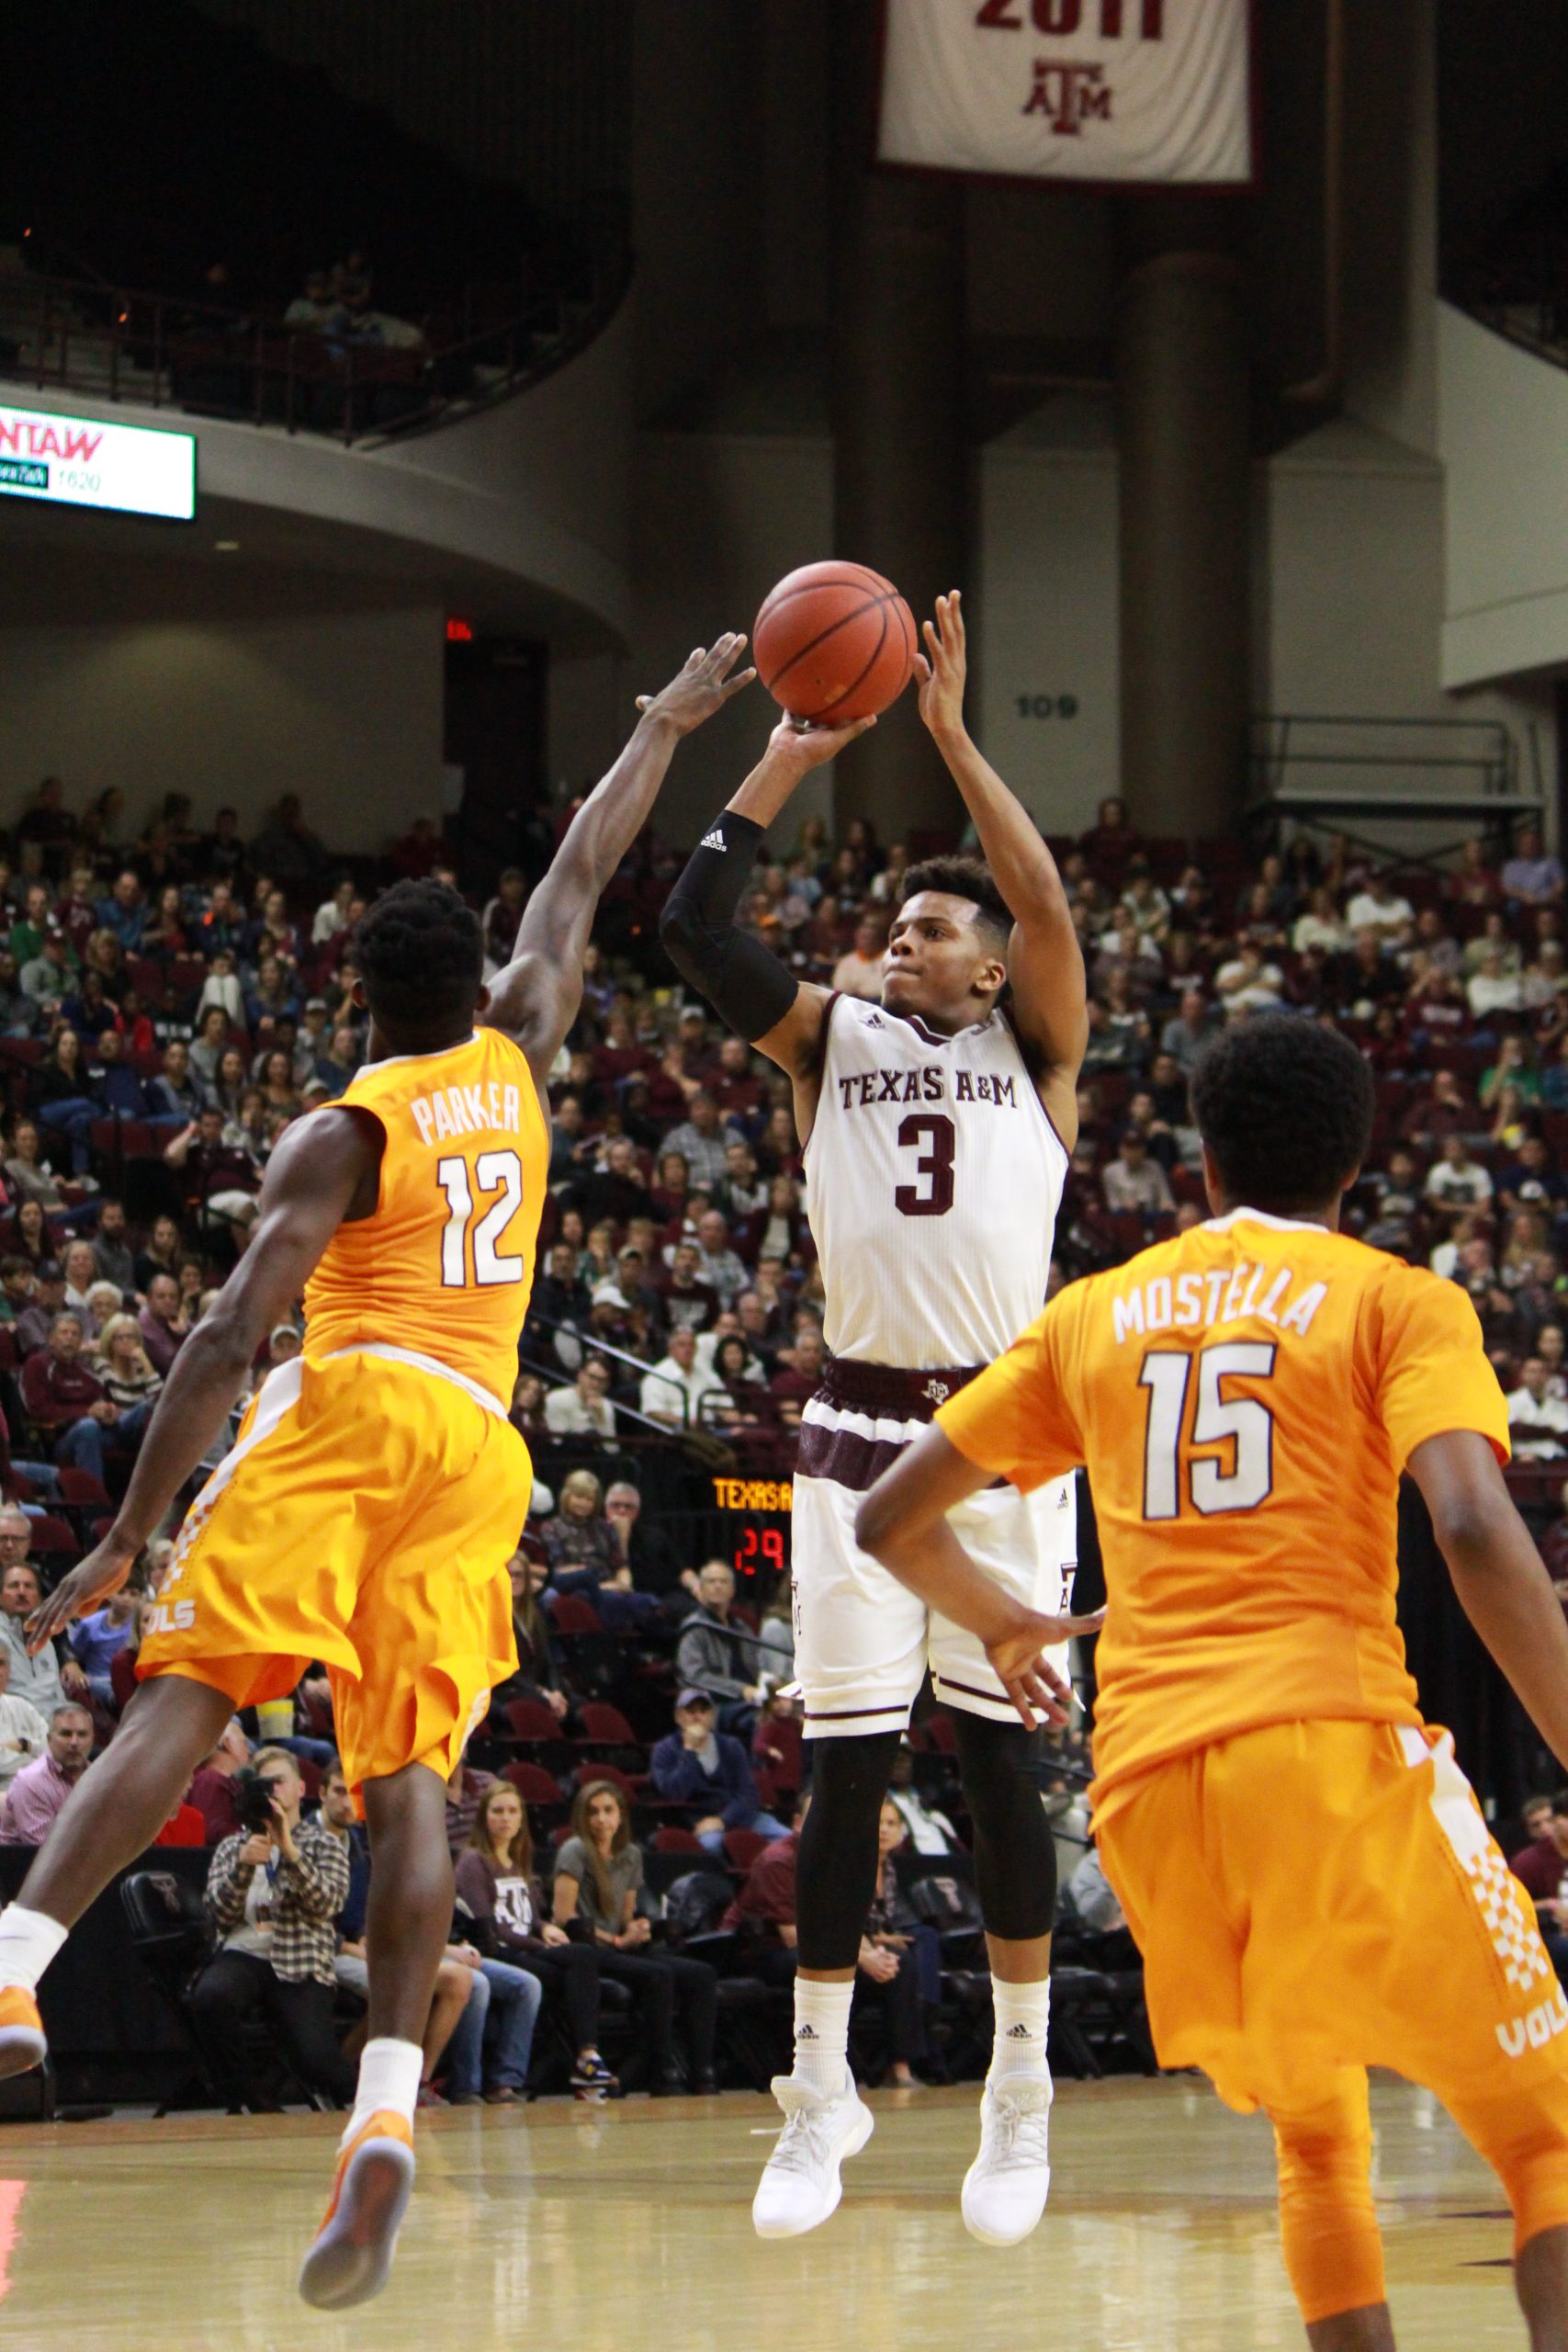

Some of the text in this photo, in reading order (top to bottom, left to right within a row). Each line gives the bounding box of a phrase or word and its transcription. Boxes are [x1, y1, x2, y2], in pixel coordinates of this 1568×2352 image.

[1017, 694, 1077, 719] 109
[411, 1081, 520, 1147] PARKER
[840, 1066, 1017, 1109] TEXAS A&M
[895, 1114, 955, 1216] 3
[436, 1148, 524, 1288] 12
[1112, 1263, 1328, 1344] MOSTELLA
[1137, 1340, 1279, 1521] 15
[735, 1528, 784, 1576] 29
